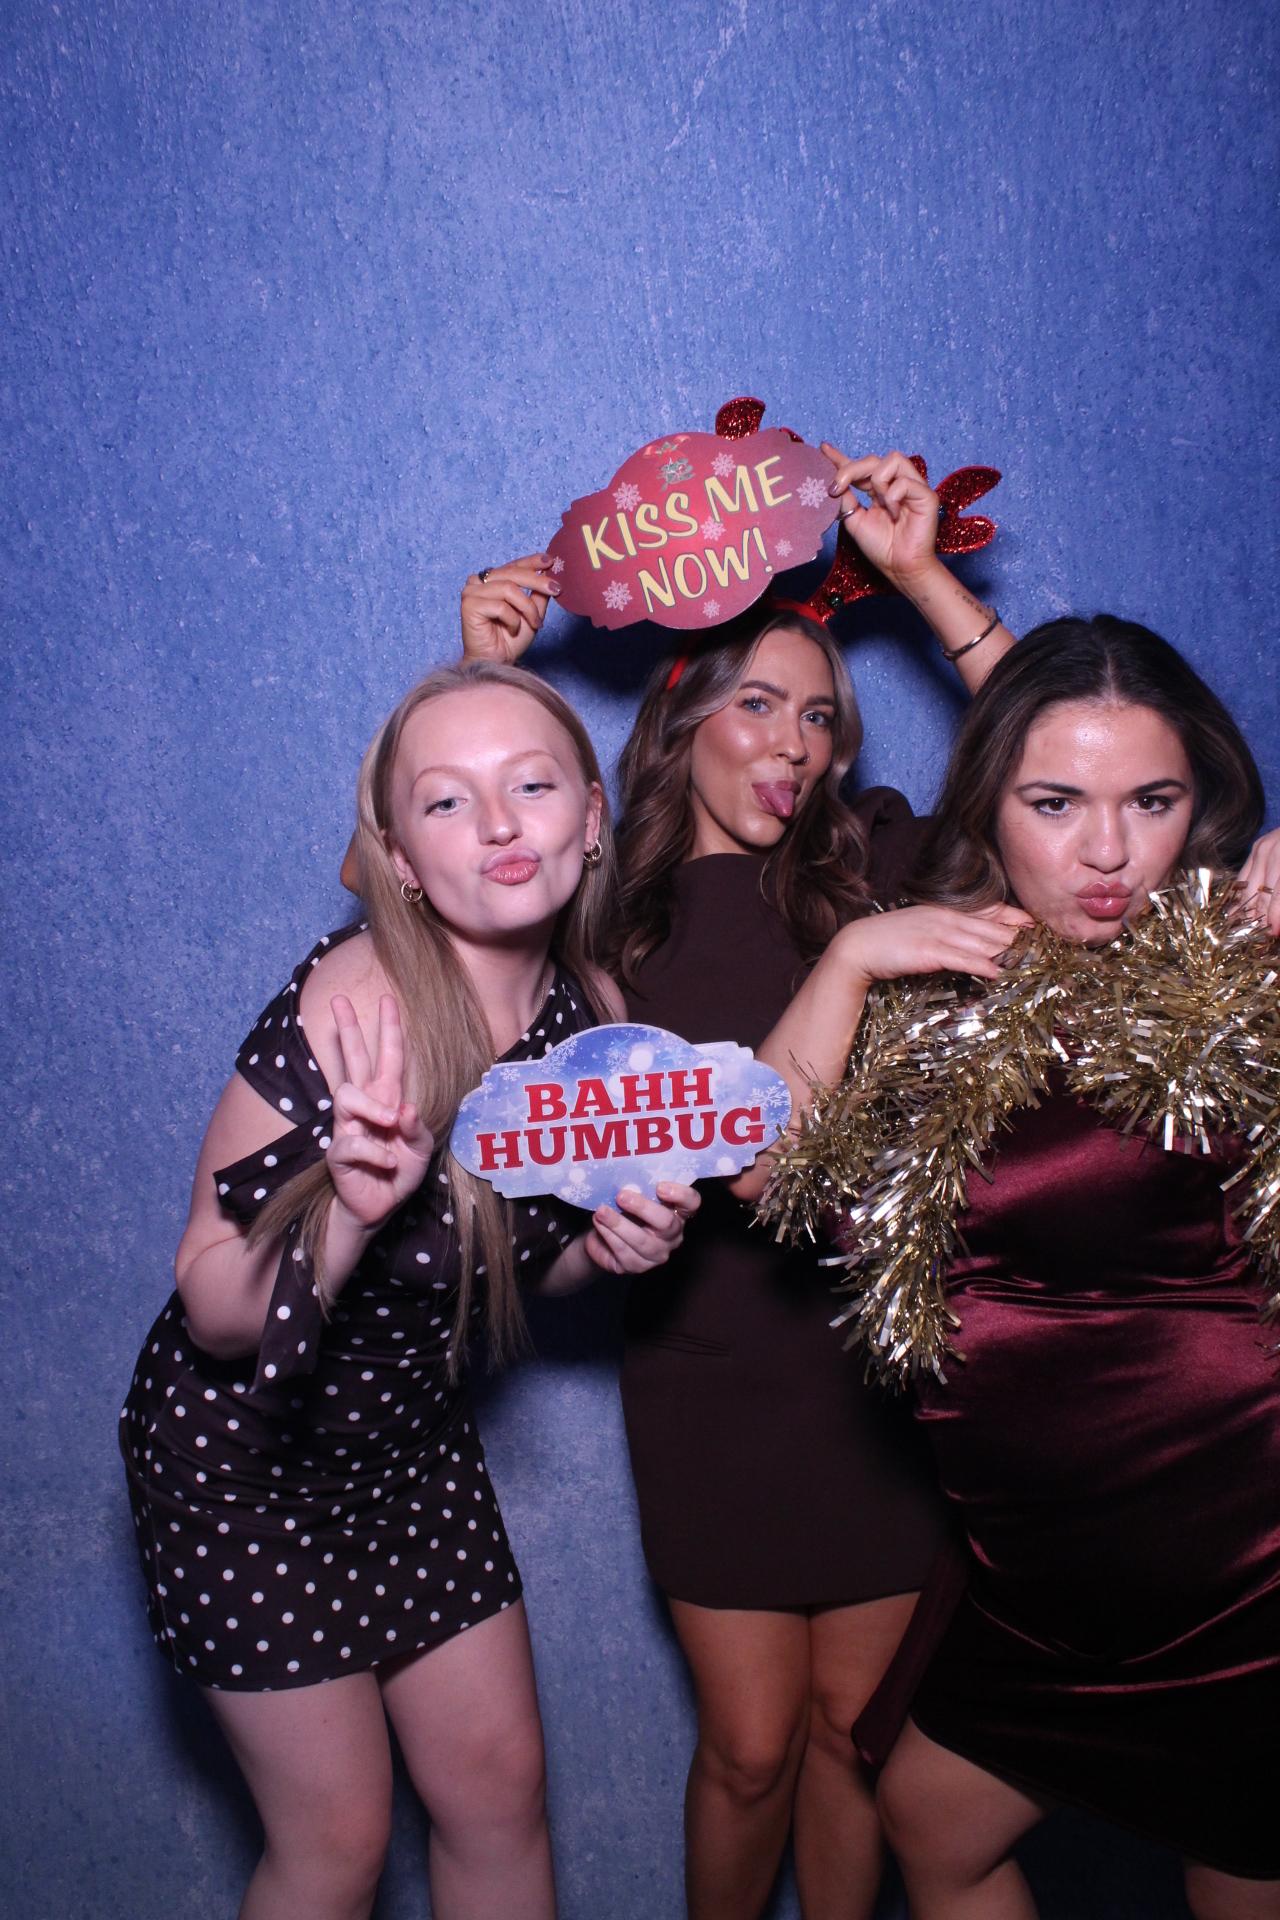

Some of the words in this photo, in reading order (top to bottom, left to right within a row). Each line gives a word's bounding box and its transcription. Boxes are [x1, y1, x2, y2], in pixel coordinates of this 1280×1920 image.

[581, 493, 698, 569] KISS
[704, 456, 792, 522] ME
[637, 527, 773, 613] NOW!
[524, 1067, 713, 1123] BAHH
[476, 1107, 766, 1171] HUMBUG
